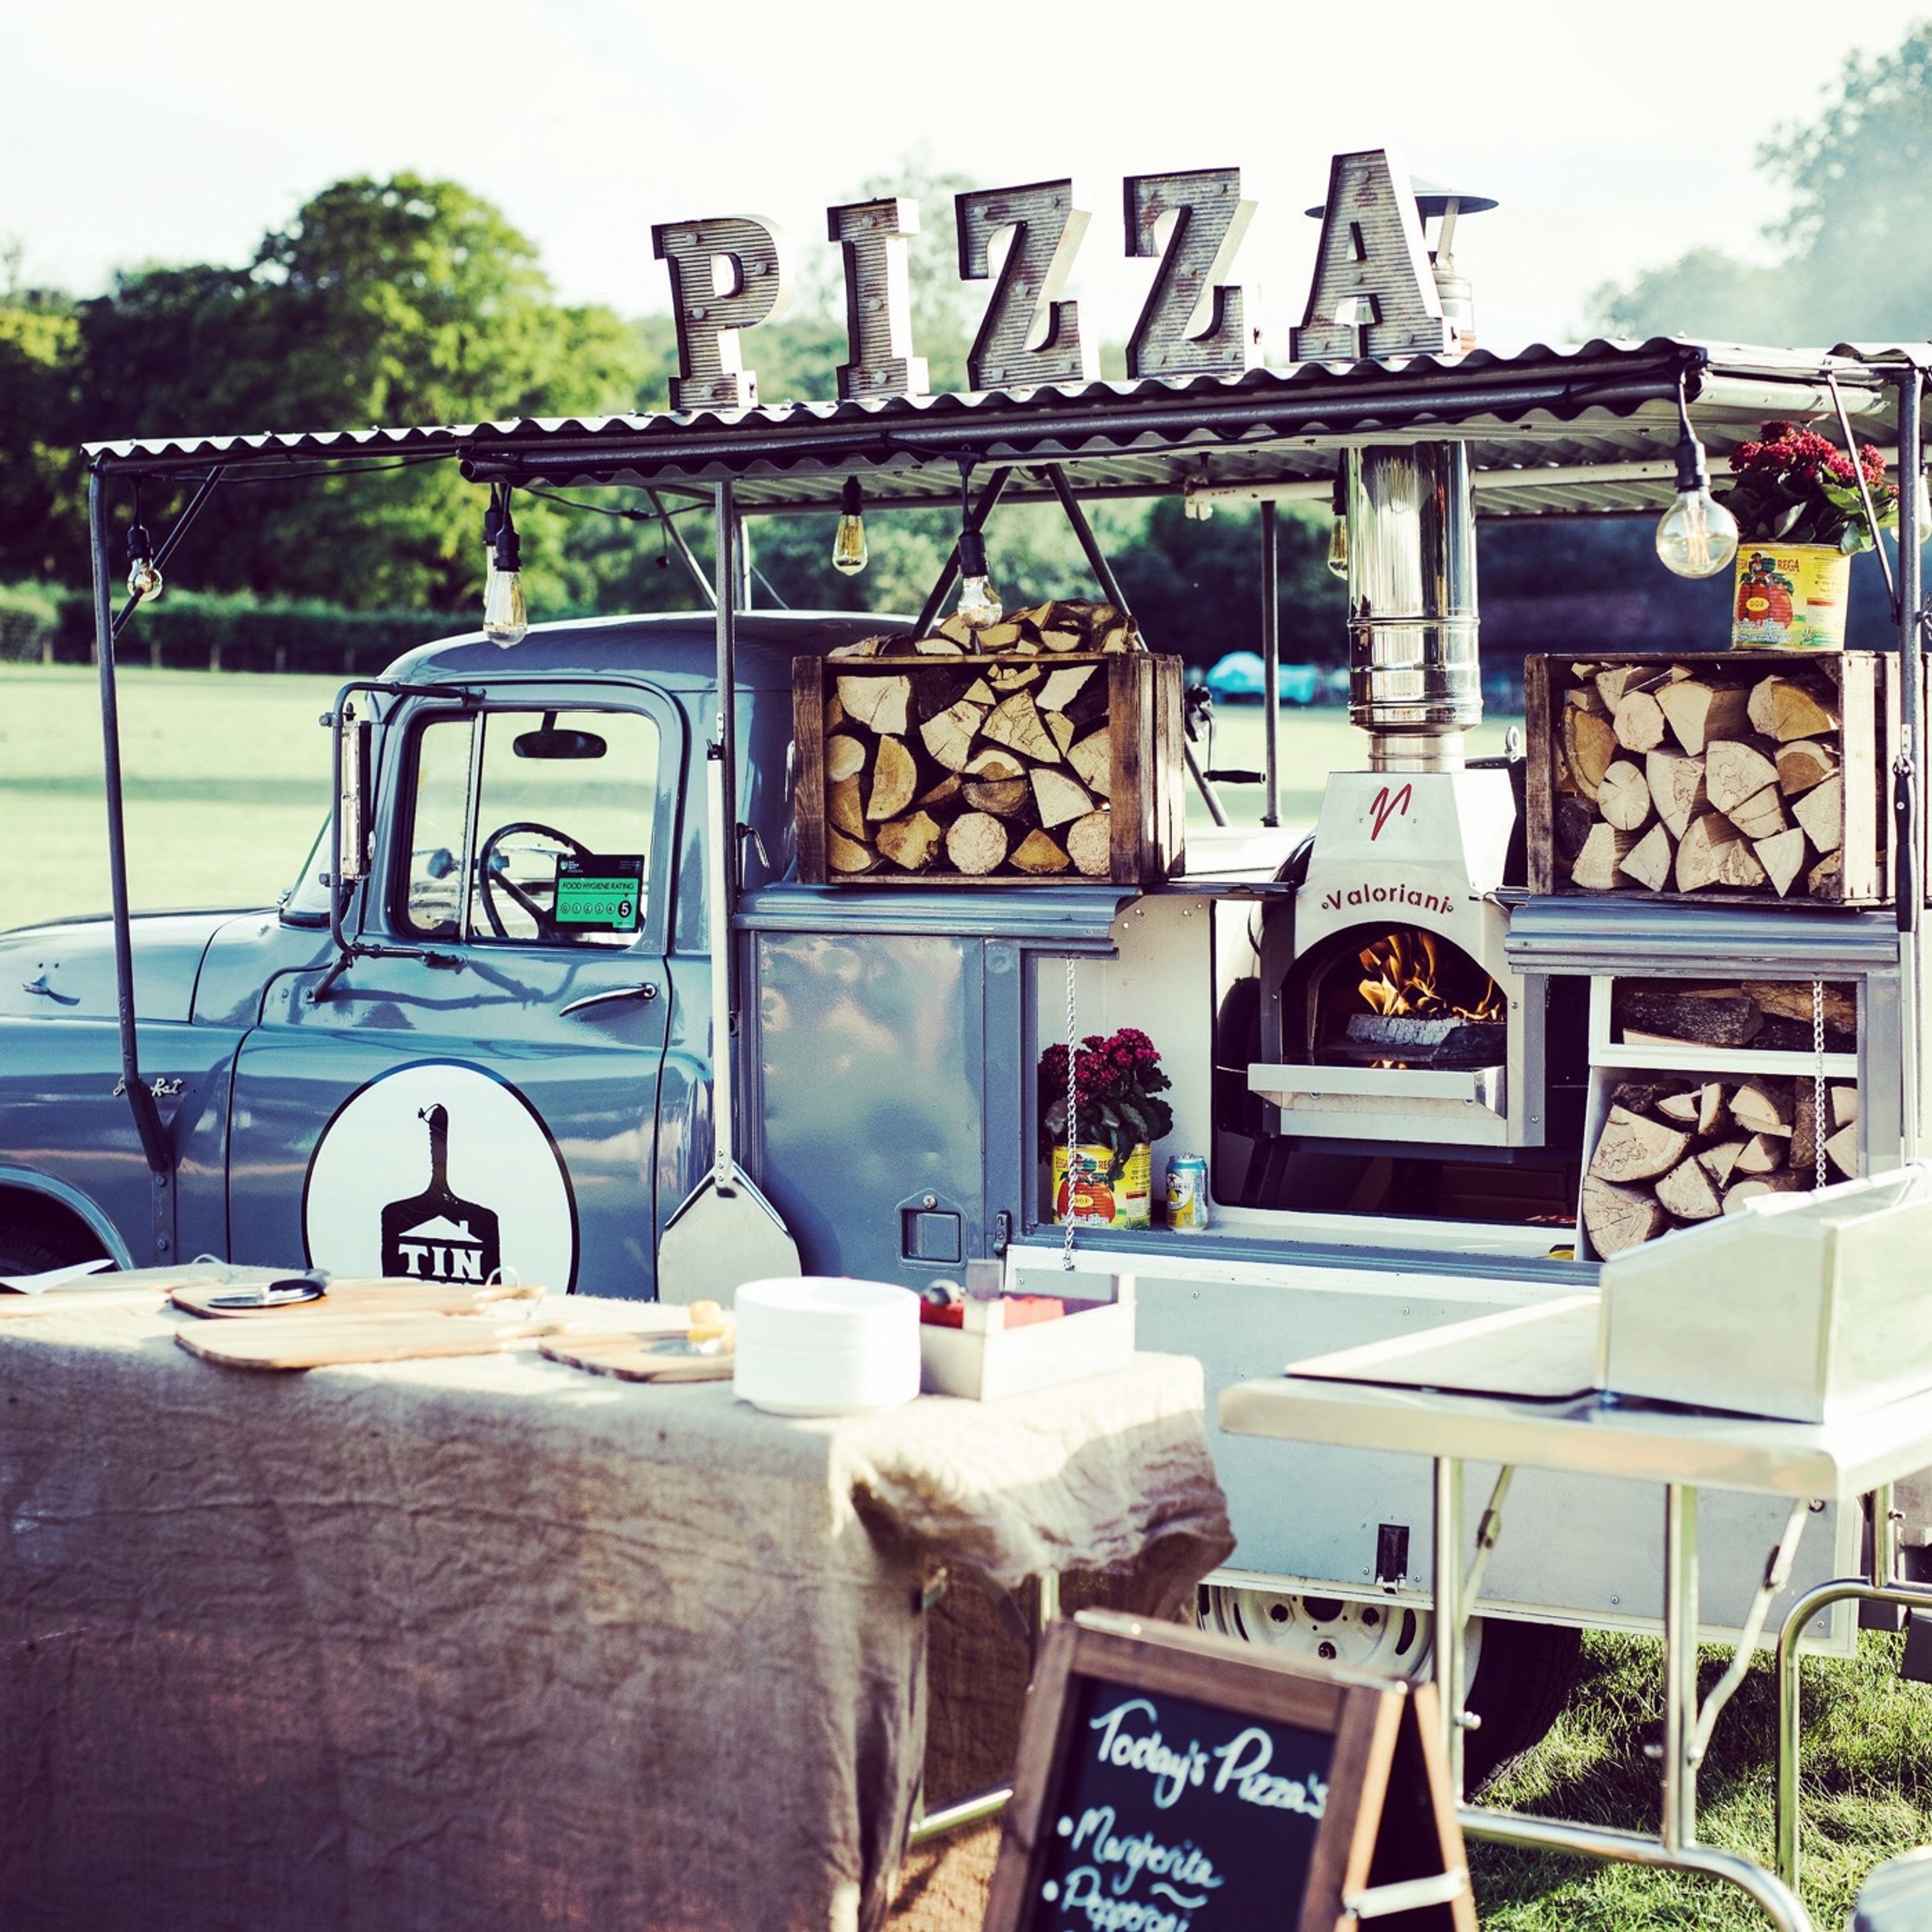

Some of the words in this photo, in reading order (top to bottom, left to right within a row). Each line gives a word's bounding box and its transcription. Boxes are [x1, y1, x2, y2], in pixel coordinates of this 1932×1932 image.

[651, 148, 1461, 410] PIZZA
[1777, 558, 1800, 572] REGA
[620, 902, 629, 916] 5
[1326, 883, 1450, 914] Valoriani
[398, 1243, 484, 1280] TIN
[1089, 1699, 1210, 1809] Today's
[1213, 1727, 1330, 1819] Pizza's
